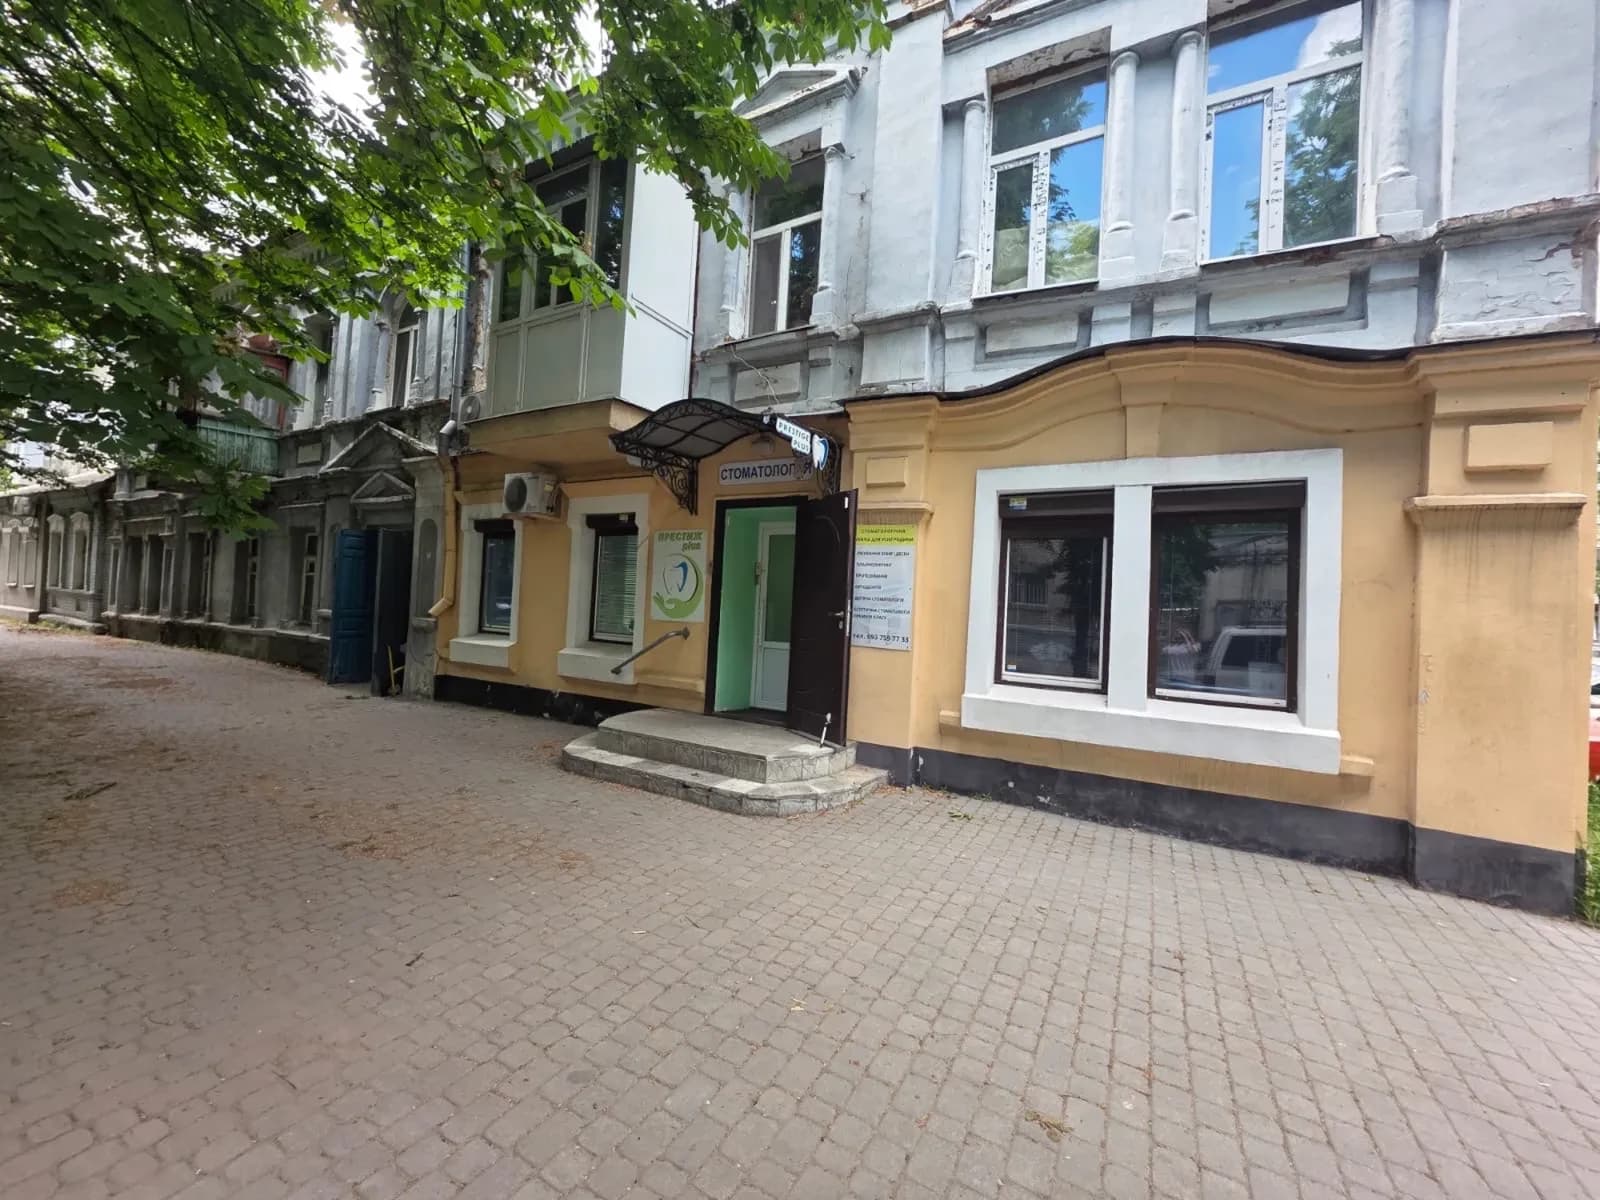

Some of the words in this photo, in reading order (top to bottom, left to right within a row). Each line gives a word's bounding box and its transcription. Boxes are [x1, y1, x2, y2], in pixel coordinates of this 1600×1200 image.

[778, 420, 810, 442] PRESTIGE
[793, 439, 809, 453] PLUS
[720, 463, 812, 481] СТОМАТОЛОГЯ
[657, 531, 703, 543] ПРЕСТИЖ
